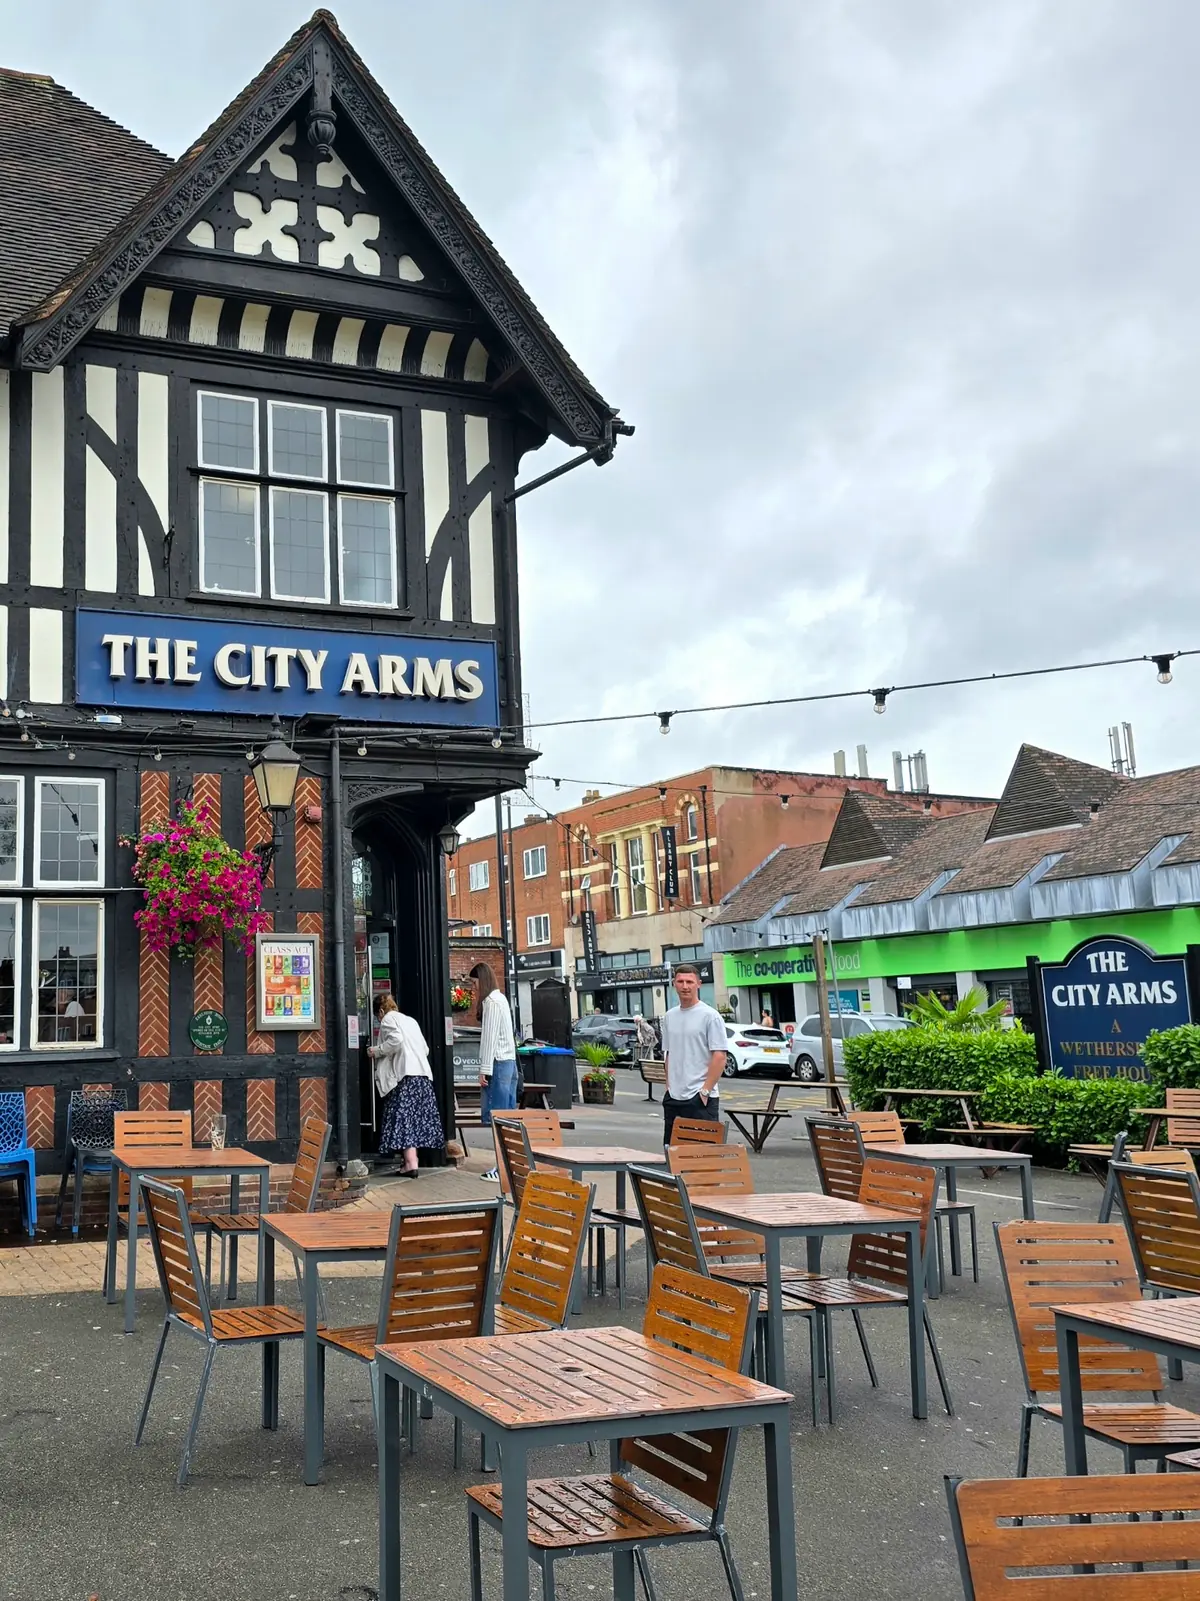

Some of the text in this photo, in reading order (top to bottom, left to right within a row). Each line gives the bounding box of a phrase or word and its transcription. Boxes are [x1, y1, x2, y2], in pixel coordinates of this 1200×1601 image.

[102, 634, 484, 701] THE CITY ARMS
[263, 946, 311, 954] CLASS ACT
[1086, 950, 1129, 973] THE
[735, 951, 860, 978] The co-operati food
[1051, 980, 1178, 1007] CITY ARMS
[1110, 1019, 1122, 1034] A
[1073, 1065, 1151, 1081] FREE HOU
